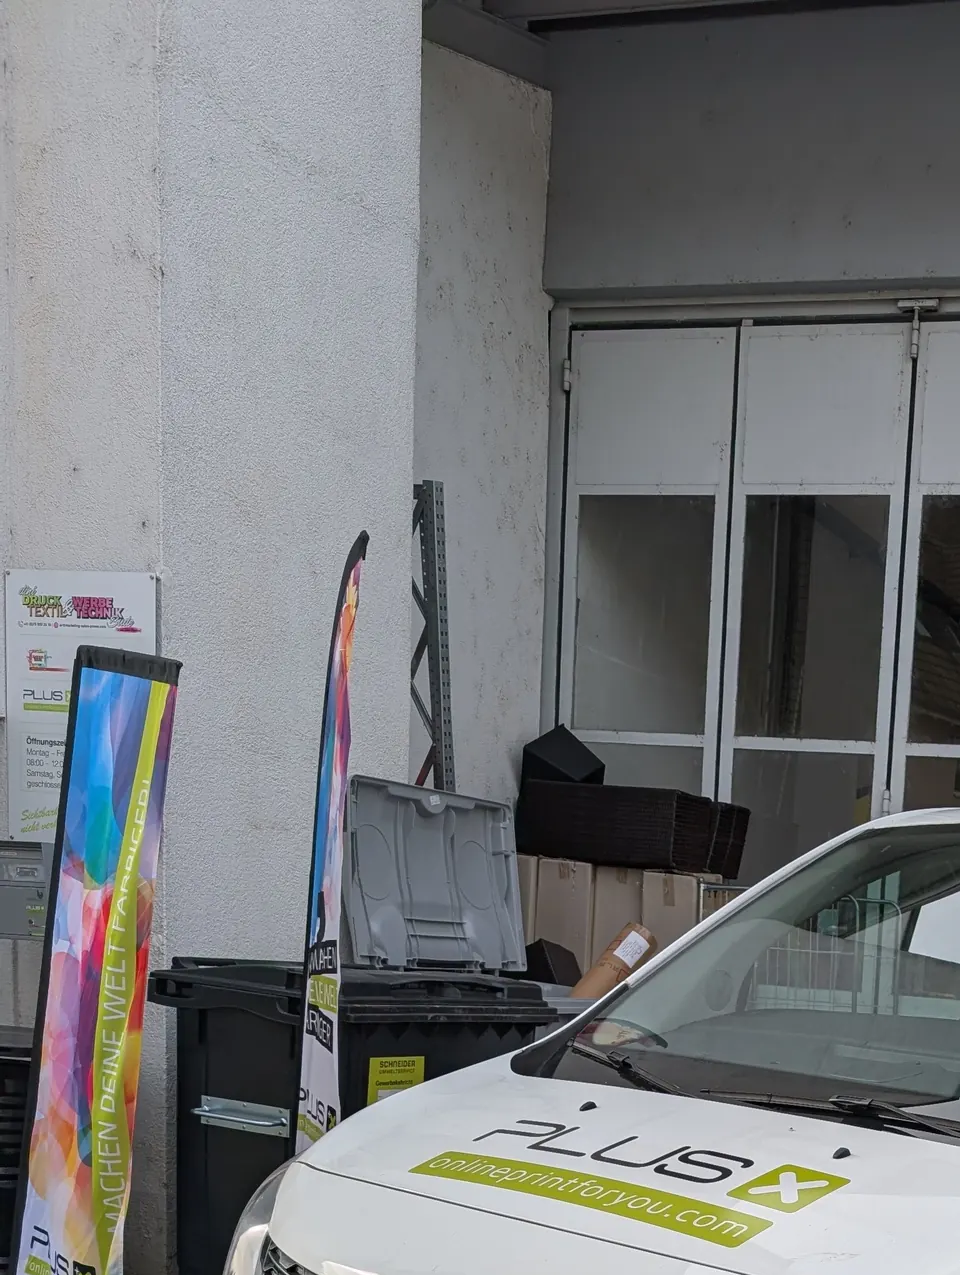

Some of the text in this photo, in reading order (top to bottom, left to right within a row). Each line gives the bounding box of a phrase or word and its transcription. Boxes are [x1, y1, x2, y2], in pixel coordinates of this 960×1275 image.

[22, 595, 62, 606] DRUCK
[72, 596, 113, 608] WERBE
[27, 605, 66, 618] TEXTIL
[63, 599, 75, 617] &
[75, 607, 124, 620] TECHNIK
[23, 689, 63, 701] PLUS
[26, 748, 49, 758] Montag
[26, 758, 44, 767] 08:00
[52, 760, 64, 768] 12:0
[27, 780, 61, 789] geschlosse
[102, 940, 126, 1023] WELT
[379, 1060, 416, 1068] SCHNEIDER
[428, 1155, 749, 1241] onlineprintforyou.com
